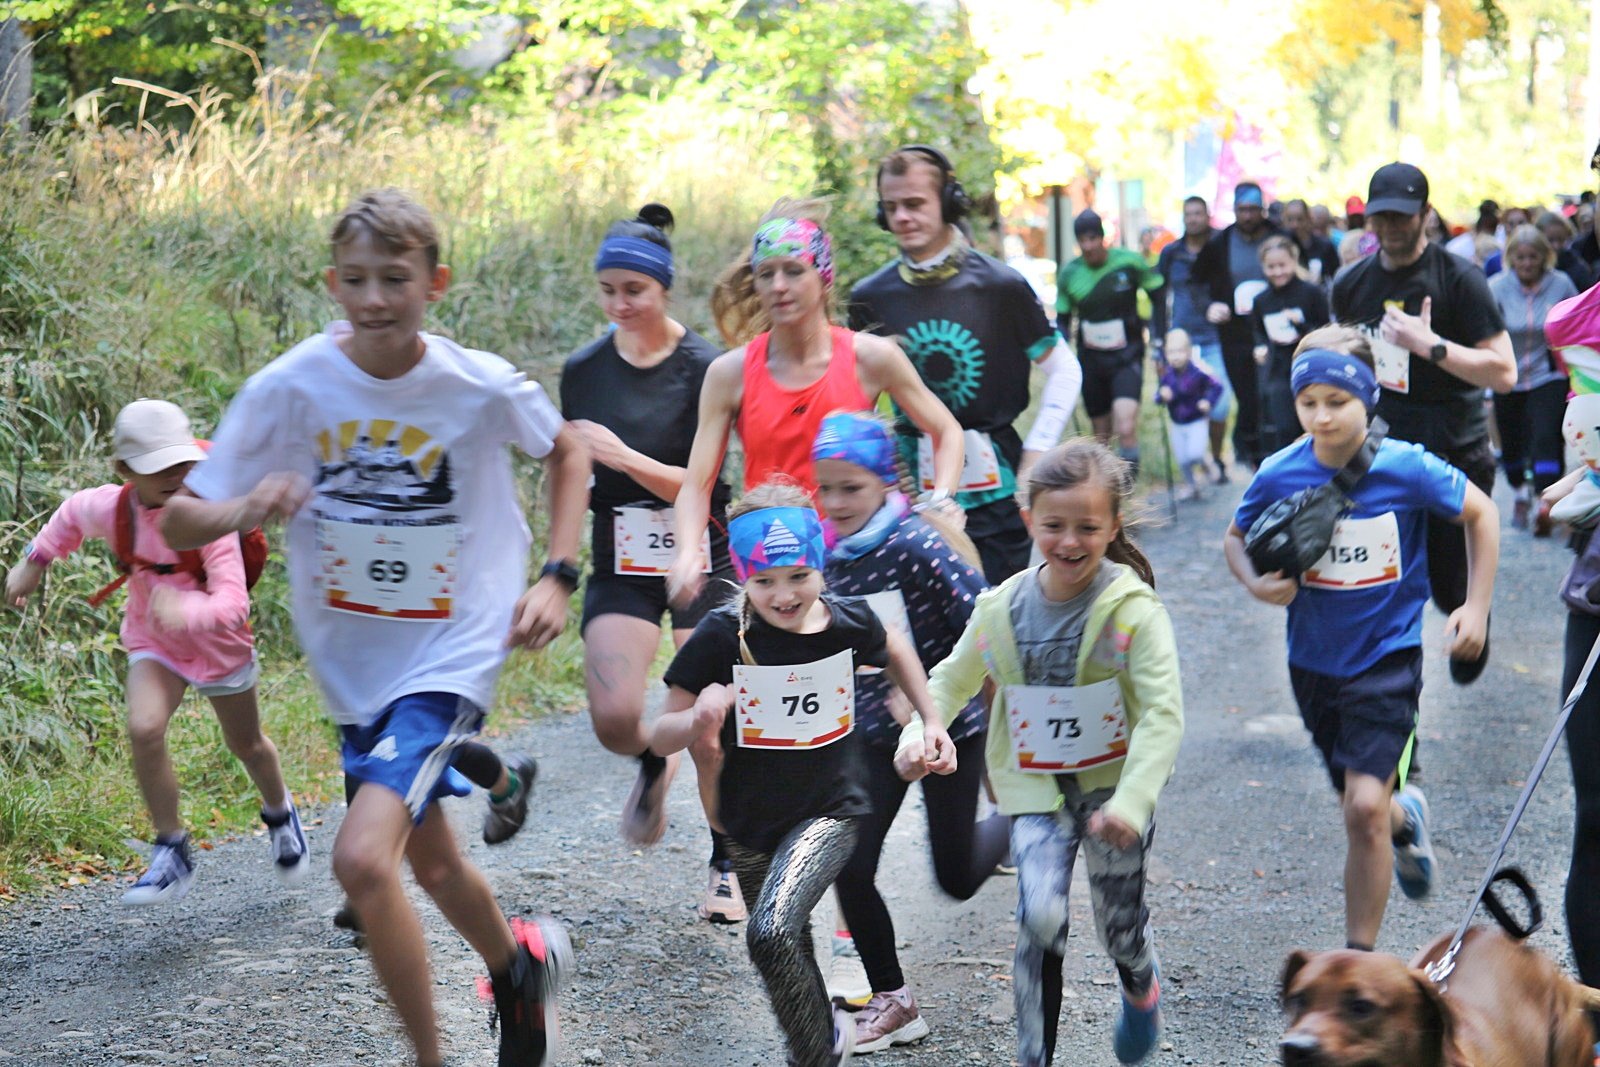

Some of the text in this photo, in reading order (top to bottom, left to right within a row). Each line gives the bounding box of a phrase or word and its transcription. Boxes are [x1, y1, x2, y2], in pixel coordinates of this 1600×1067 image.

[648, 532, 676, 549] 26
[1330, 546, 1369, 563] 158
[369, 559, 409, 584] 69
[782, 692, 820, 717] 76
[1048, 717, 1082, 739] 73
